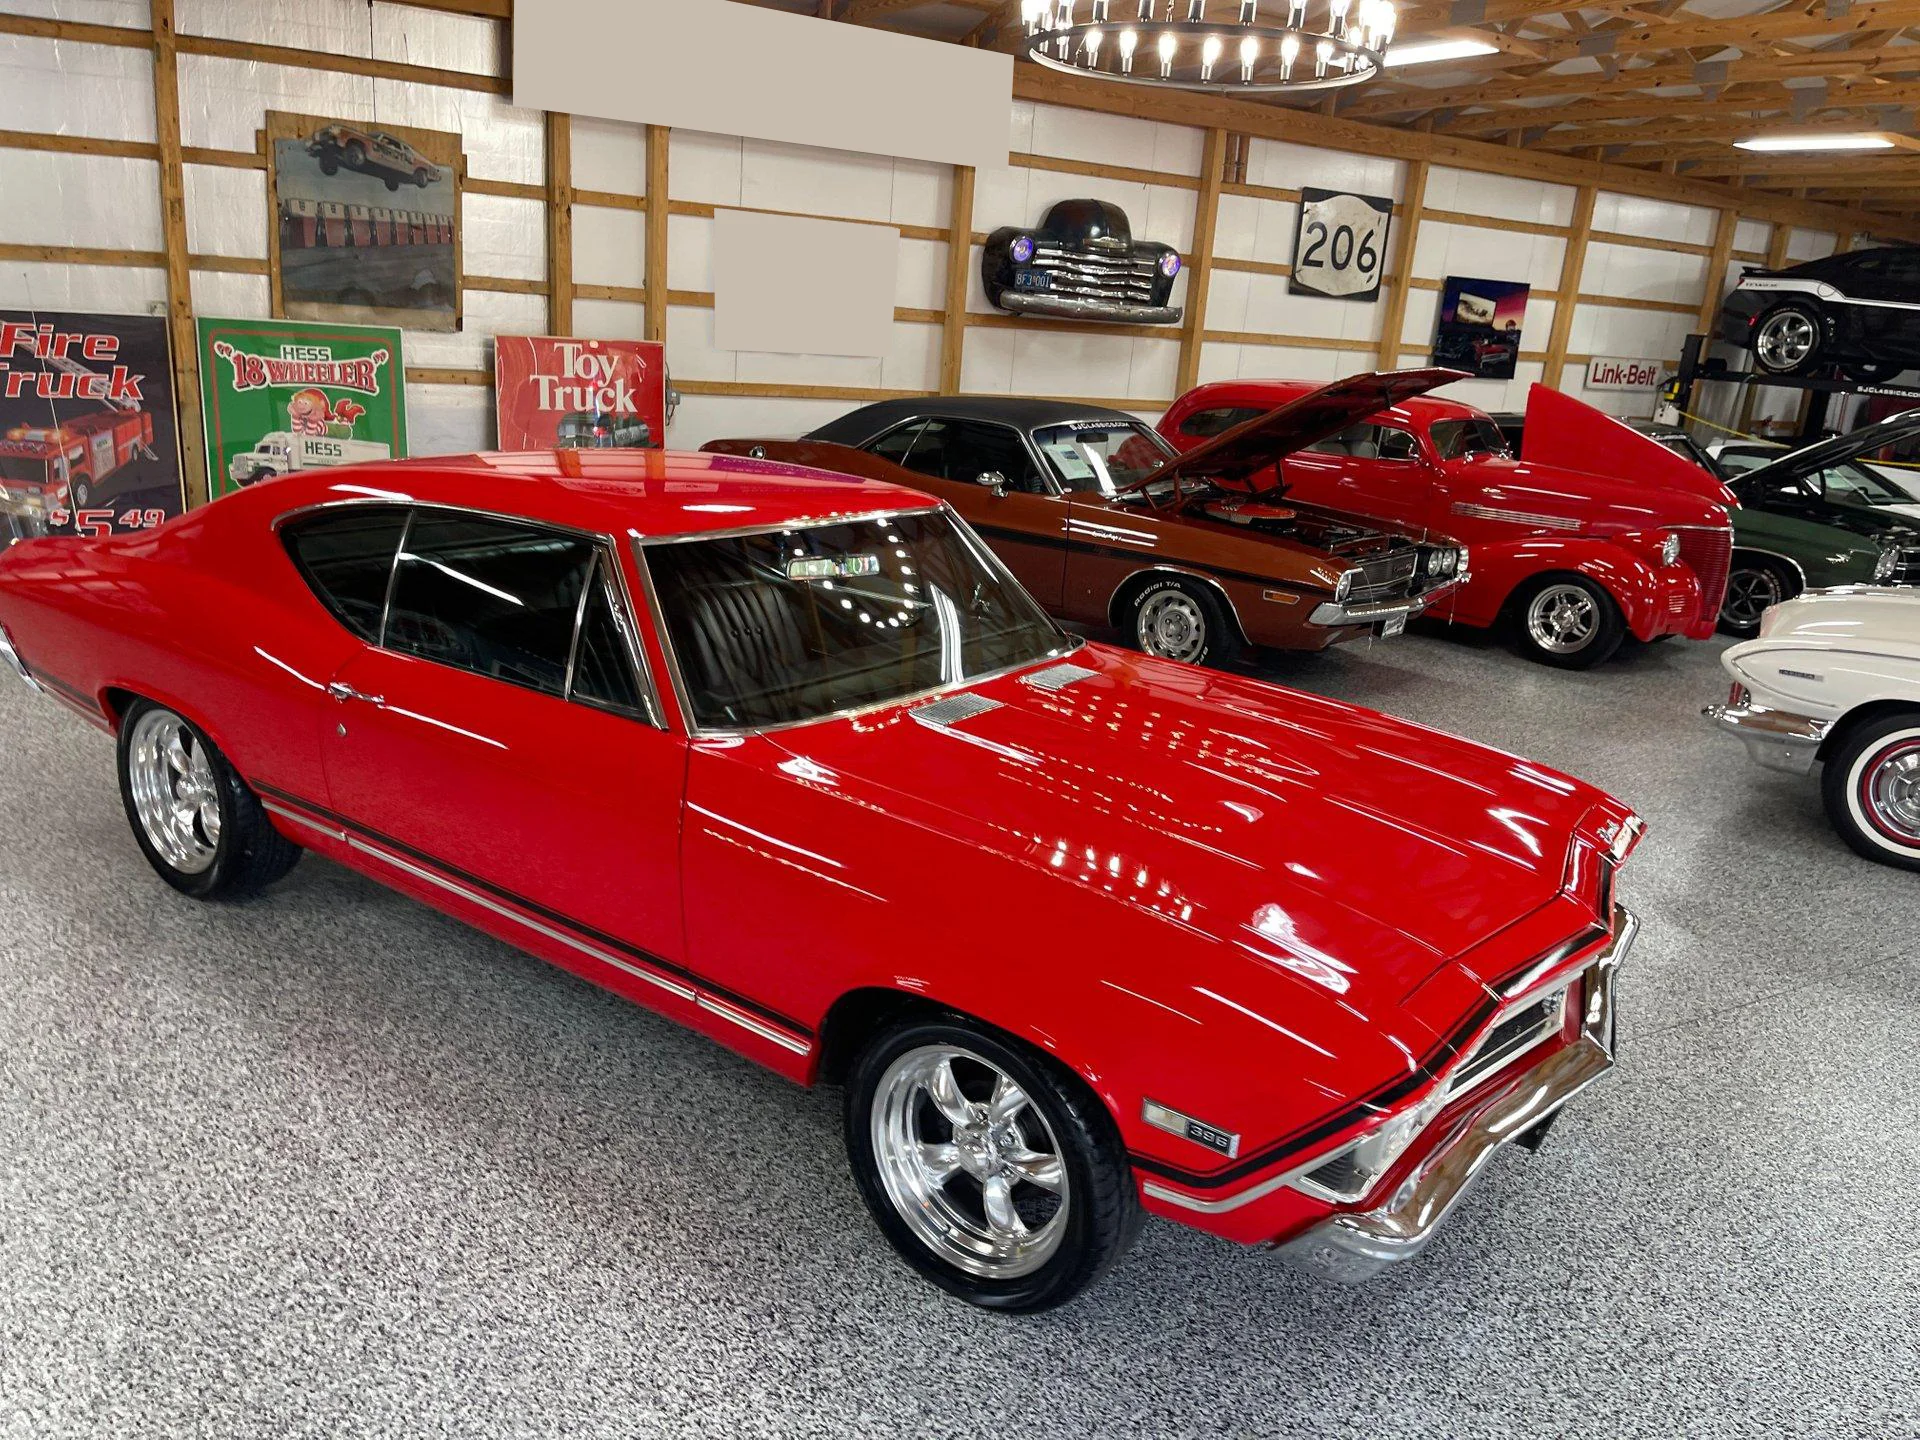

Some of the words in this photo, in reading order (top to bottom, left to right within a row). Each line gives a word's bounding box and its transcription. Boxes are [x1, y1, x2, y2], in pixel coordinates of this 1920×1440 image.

[1301, 221, 1377, 273] 206
[0, 322, 120, 361] Fire
[282, 346, 330, 361] HESS
[0, 362, 146, 400] ruck
[553, 342, 620, 388] Toy
[1592, 363, 1656, 385] Link-Belt
[529, 374, 639, 413] Truck
[1857, 385, 1920, 398] SJCLASSICS.CO
[304, 440, 342, 457] HESS
[1134, 582, 1163, 607] Radial
[1165, 581, 1181, 589] T/A
